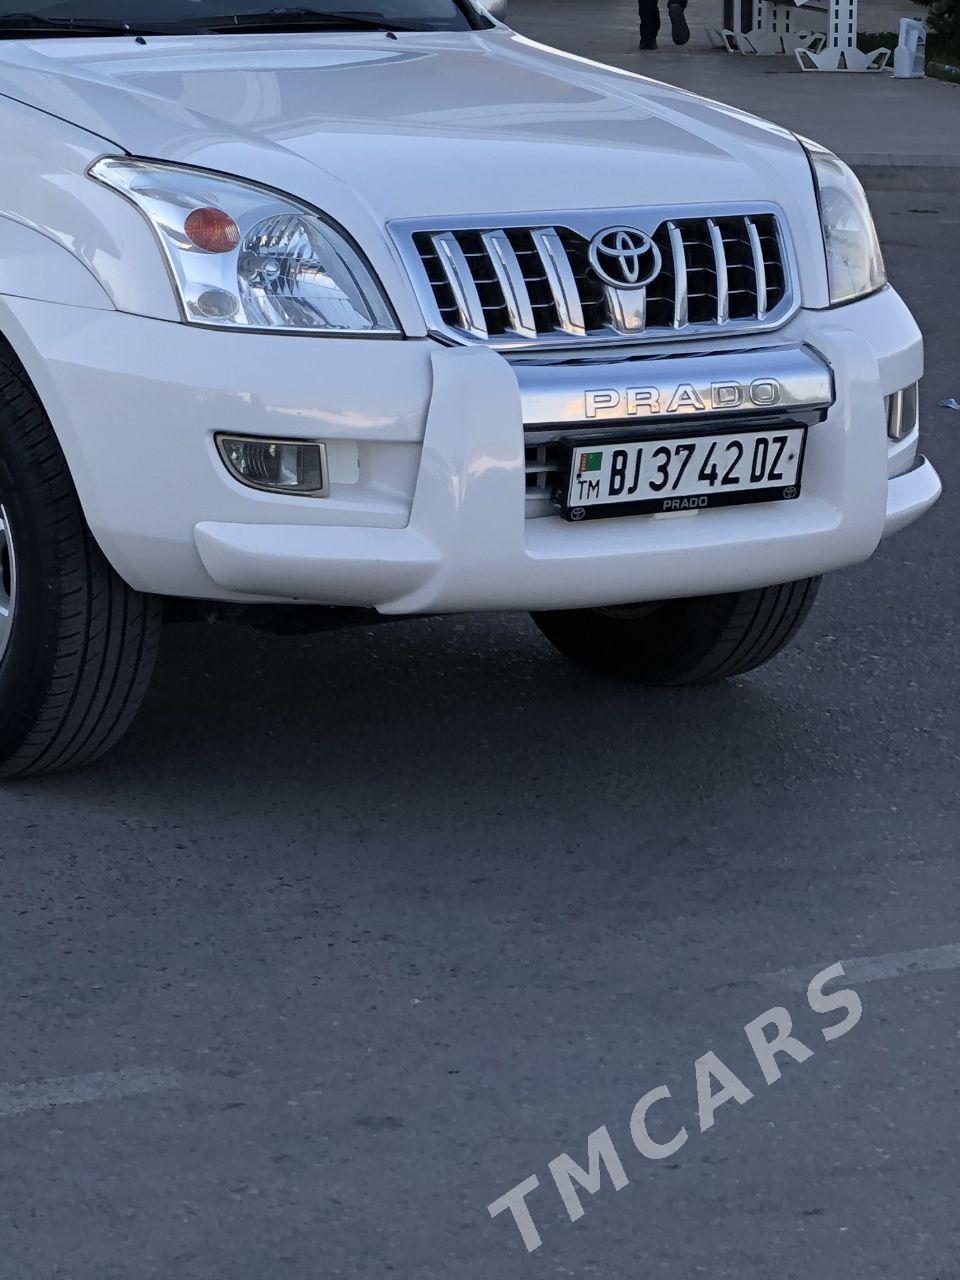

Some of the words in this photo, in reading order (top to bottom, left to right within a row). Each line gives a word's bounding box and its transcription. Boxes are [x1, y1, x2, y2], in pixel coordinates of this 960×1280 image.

[584, 376, 782, 418] PRADO
[578, 479, 601, 500] TM
[662, 496, 709, 511] PRADO
